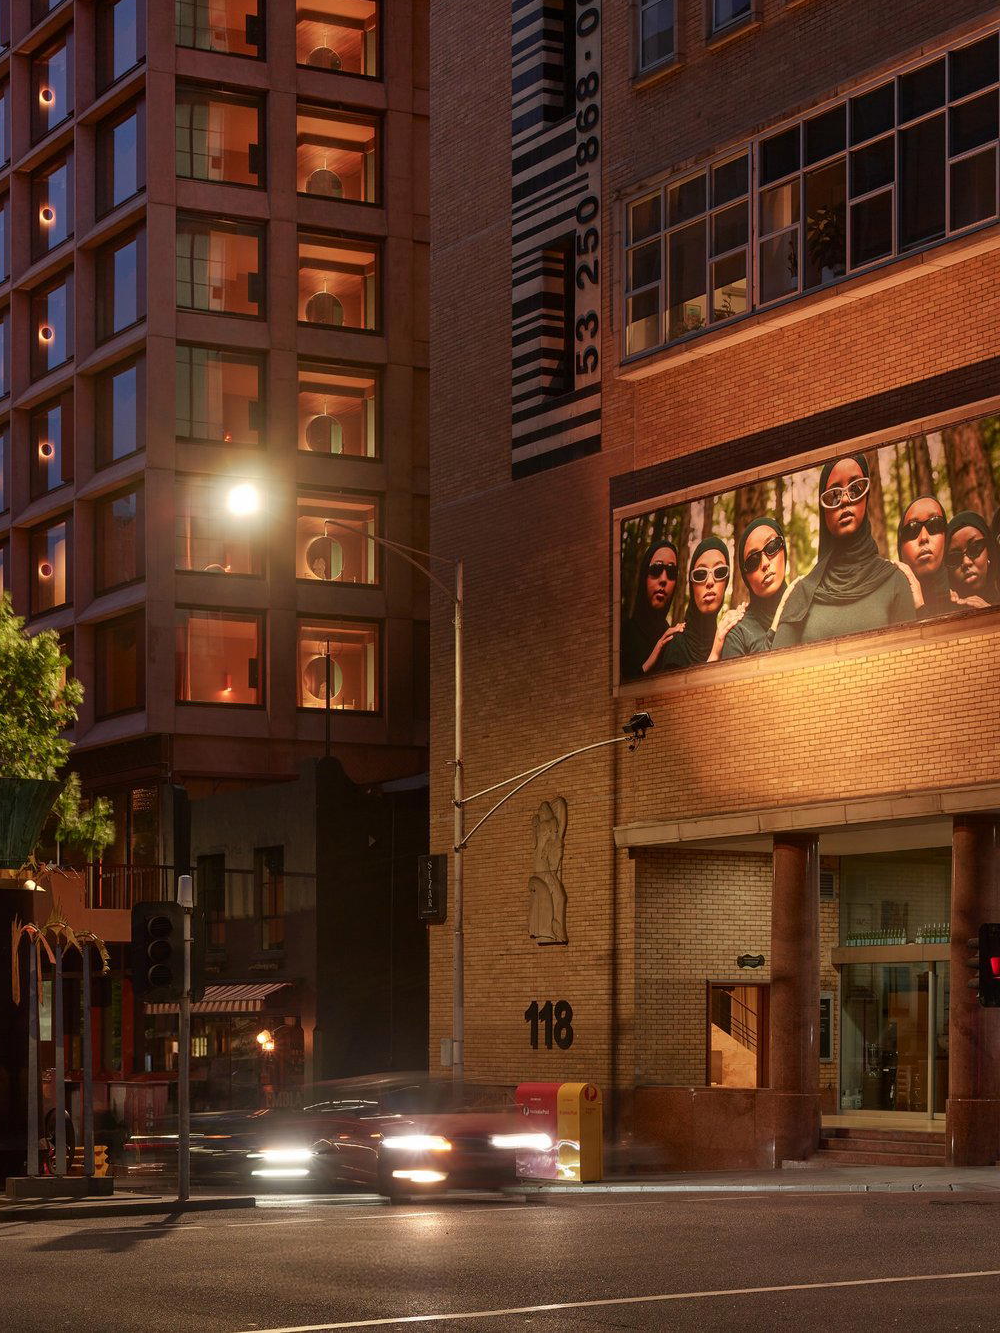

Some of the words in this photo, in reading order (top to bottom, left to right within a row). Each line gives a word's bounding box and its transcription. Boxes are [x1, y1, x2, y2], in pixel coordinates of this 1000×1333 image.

[575, 195, 599, 290] 250
[575, 310, 599, 375] 53
[524, 1000, 574, 1050] 118
